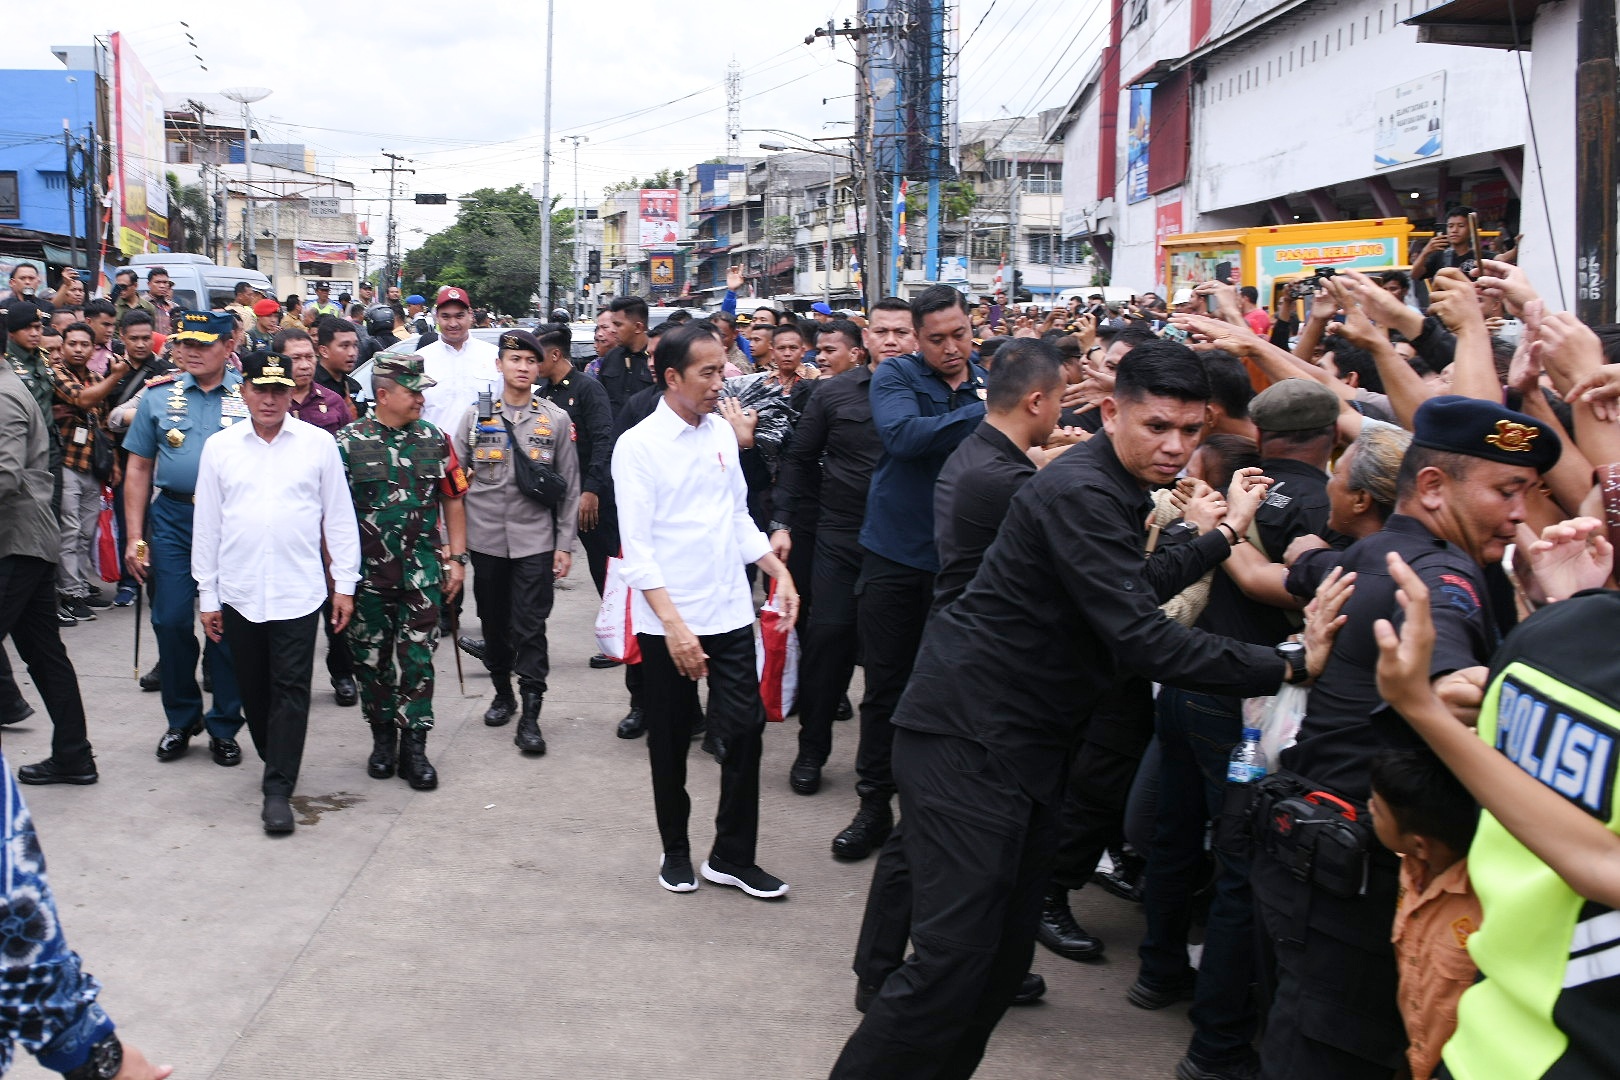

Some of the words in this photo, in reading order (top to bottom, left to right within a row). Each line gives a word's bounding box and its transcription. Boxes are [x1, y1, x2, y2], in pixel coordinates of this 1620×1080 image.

[1276, 248, 1319, 262] PASAR
[1323, 243, 1384, 258] KELILING
[1496, 681, 1614, 811] POLISI
